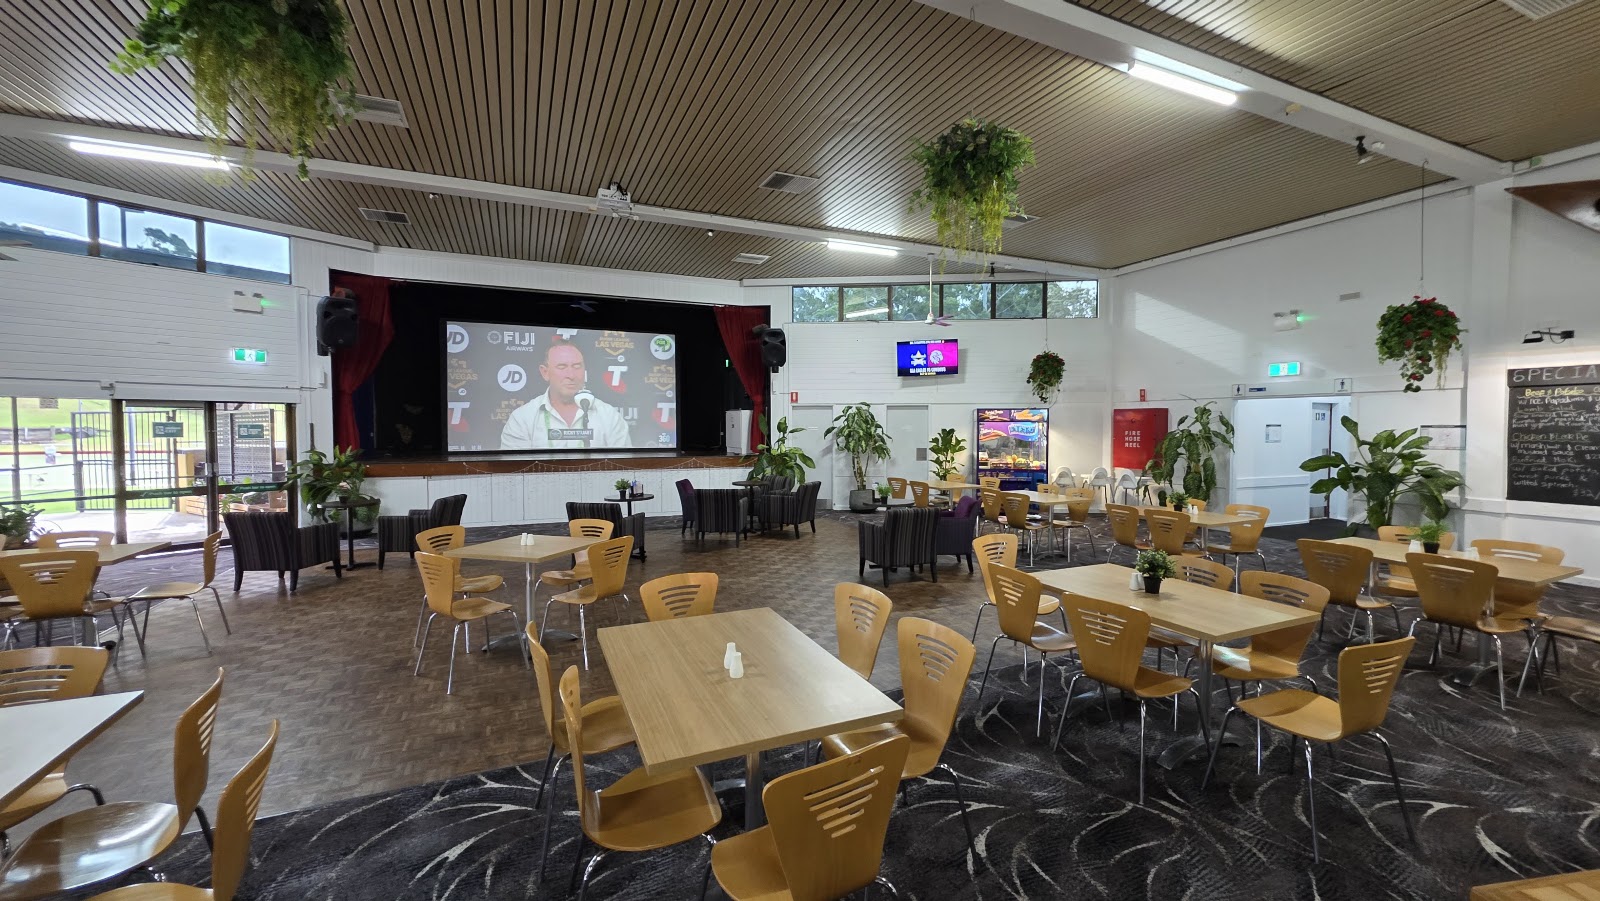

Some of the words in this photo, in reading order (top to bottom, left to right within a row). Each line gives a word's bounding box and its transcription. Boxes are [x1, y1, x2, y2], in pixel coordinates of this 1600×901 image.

[503, 331, 535, 345] FIJI
[611, 341, 634, 349] VEGAS
[502, 371, 523, 383] JD
